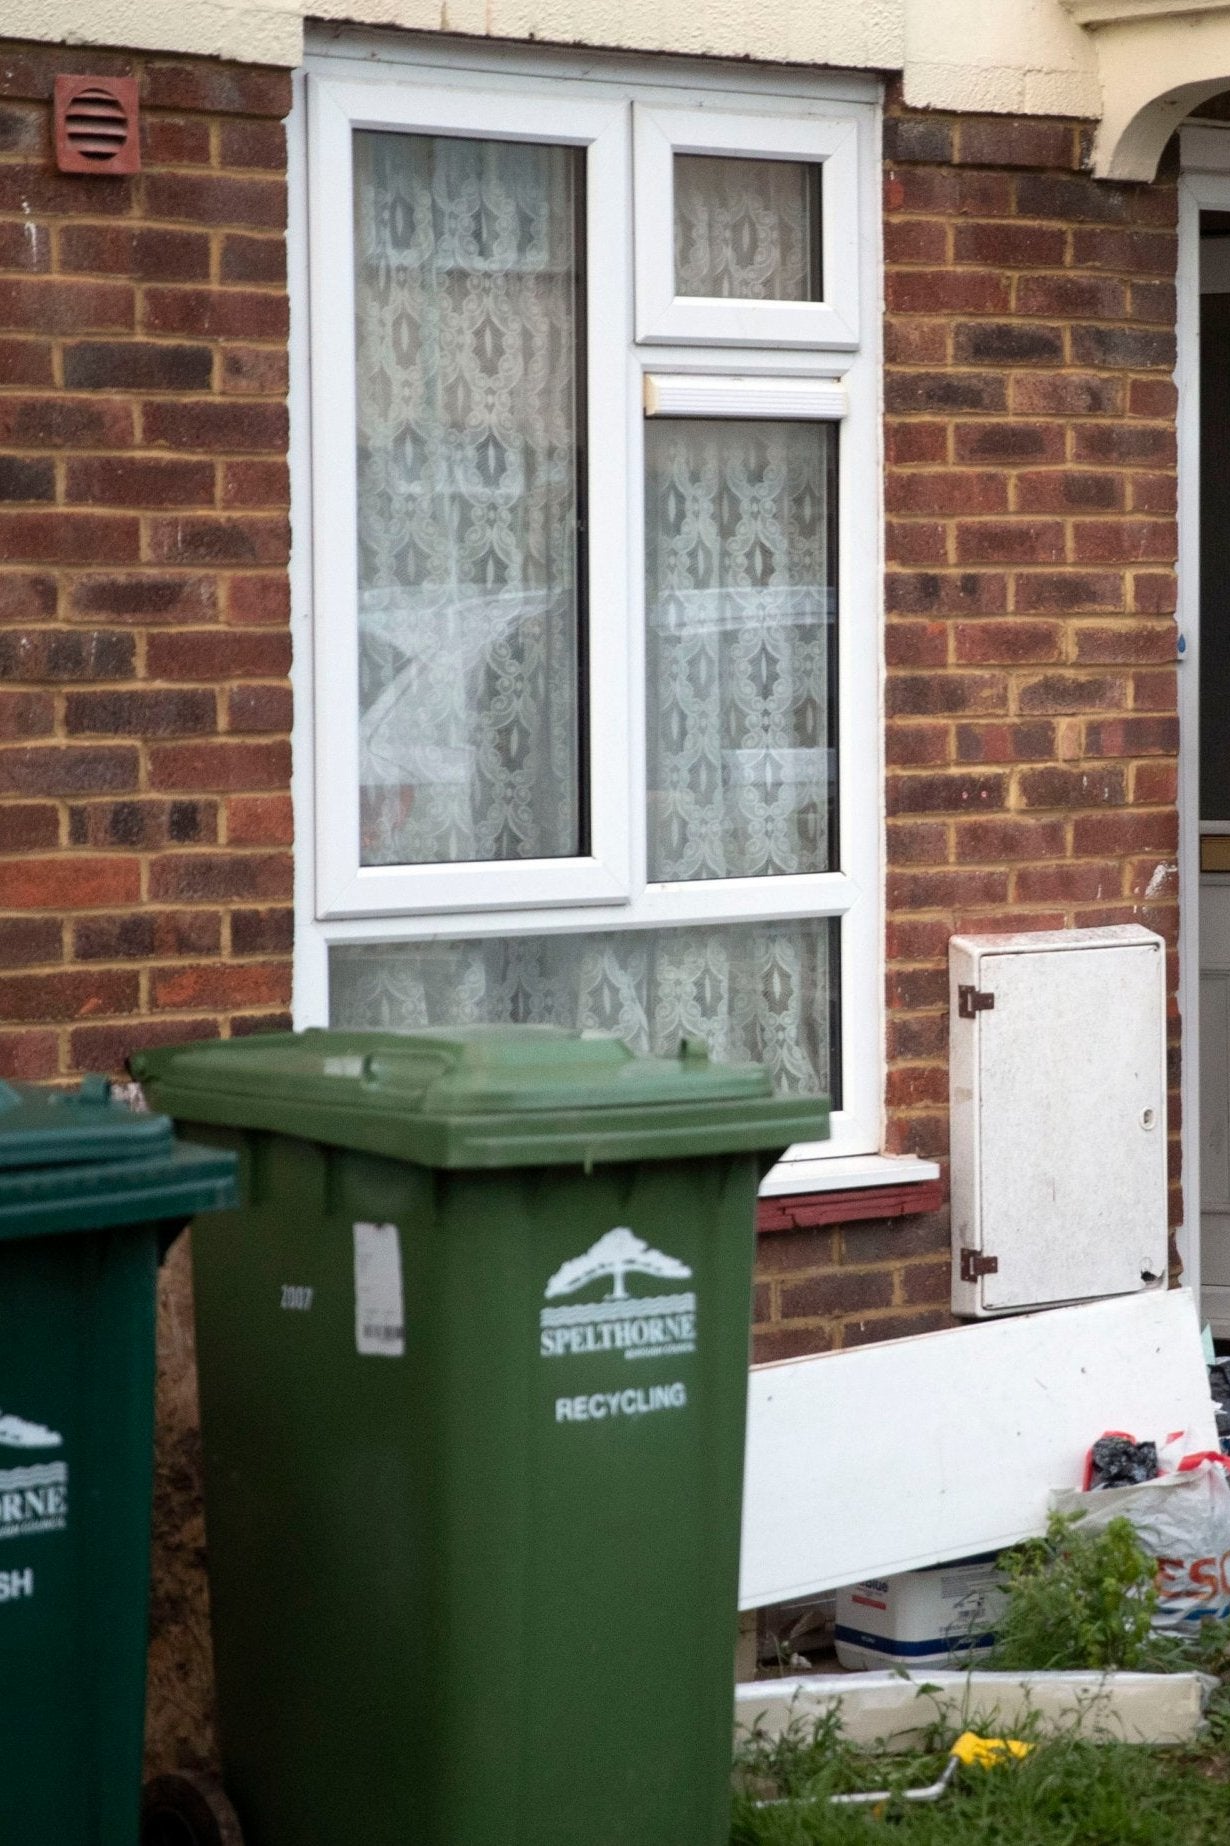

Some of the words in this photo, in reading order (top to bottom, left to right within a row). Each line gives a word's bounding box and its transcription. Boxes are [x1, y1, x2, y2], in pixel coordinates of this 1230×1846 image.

[540, 1313, 696, 1357] SPELTHORNE
[555, 1381, 687, 1423] RECYCLING
[0, 1485, 67, 1522] RNE
